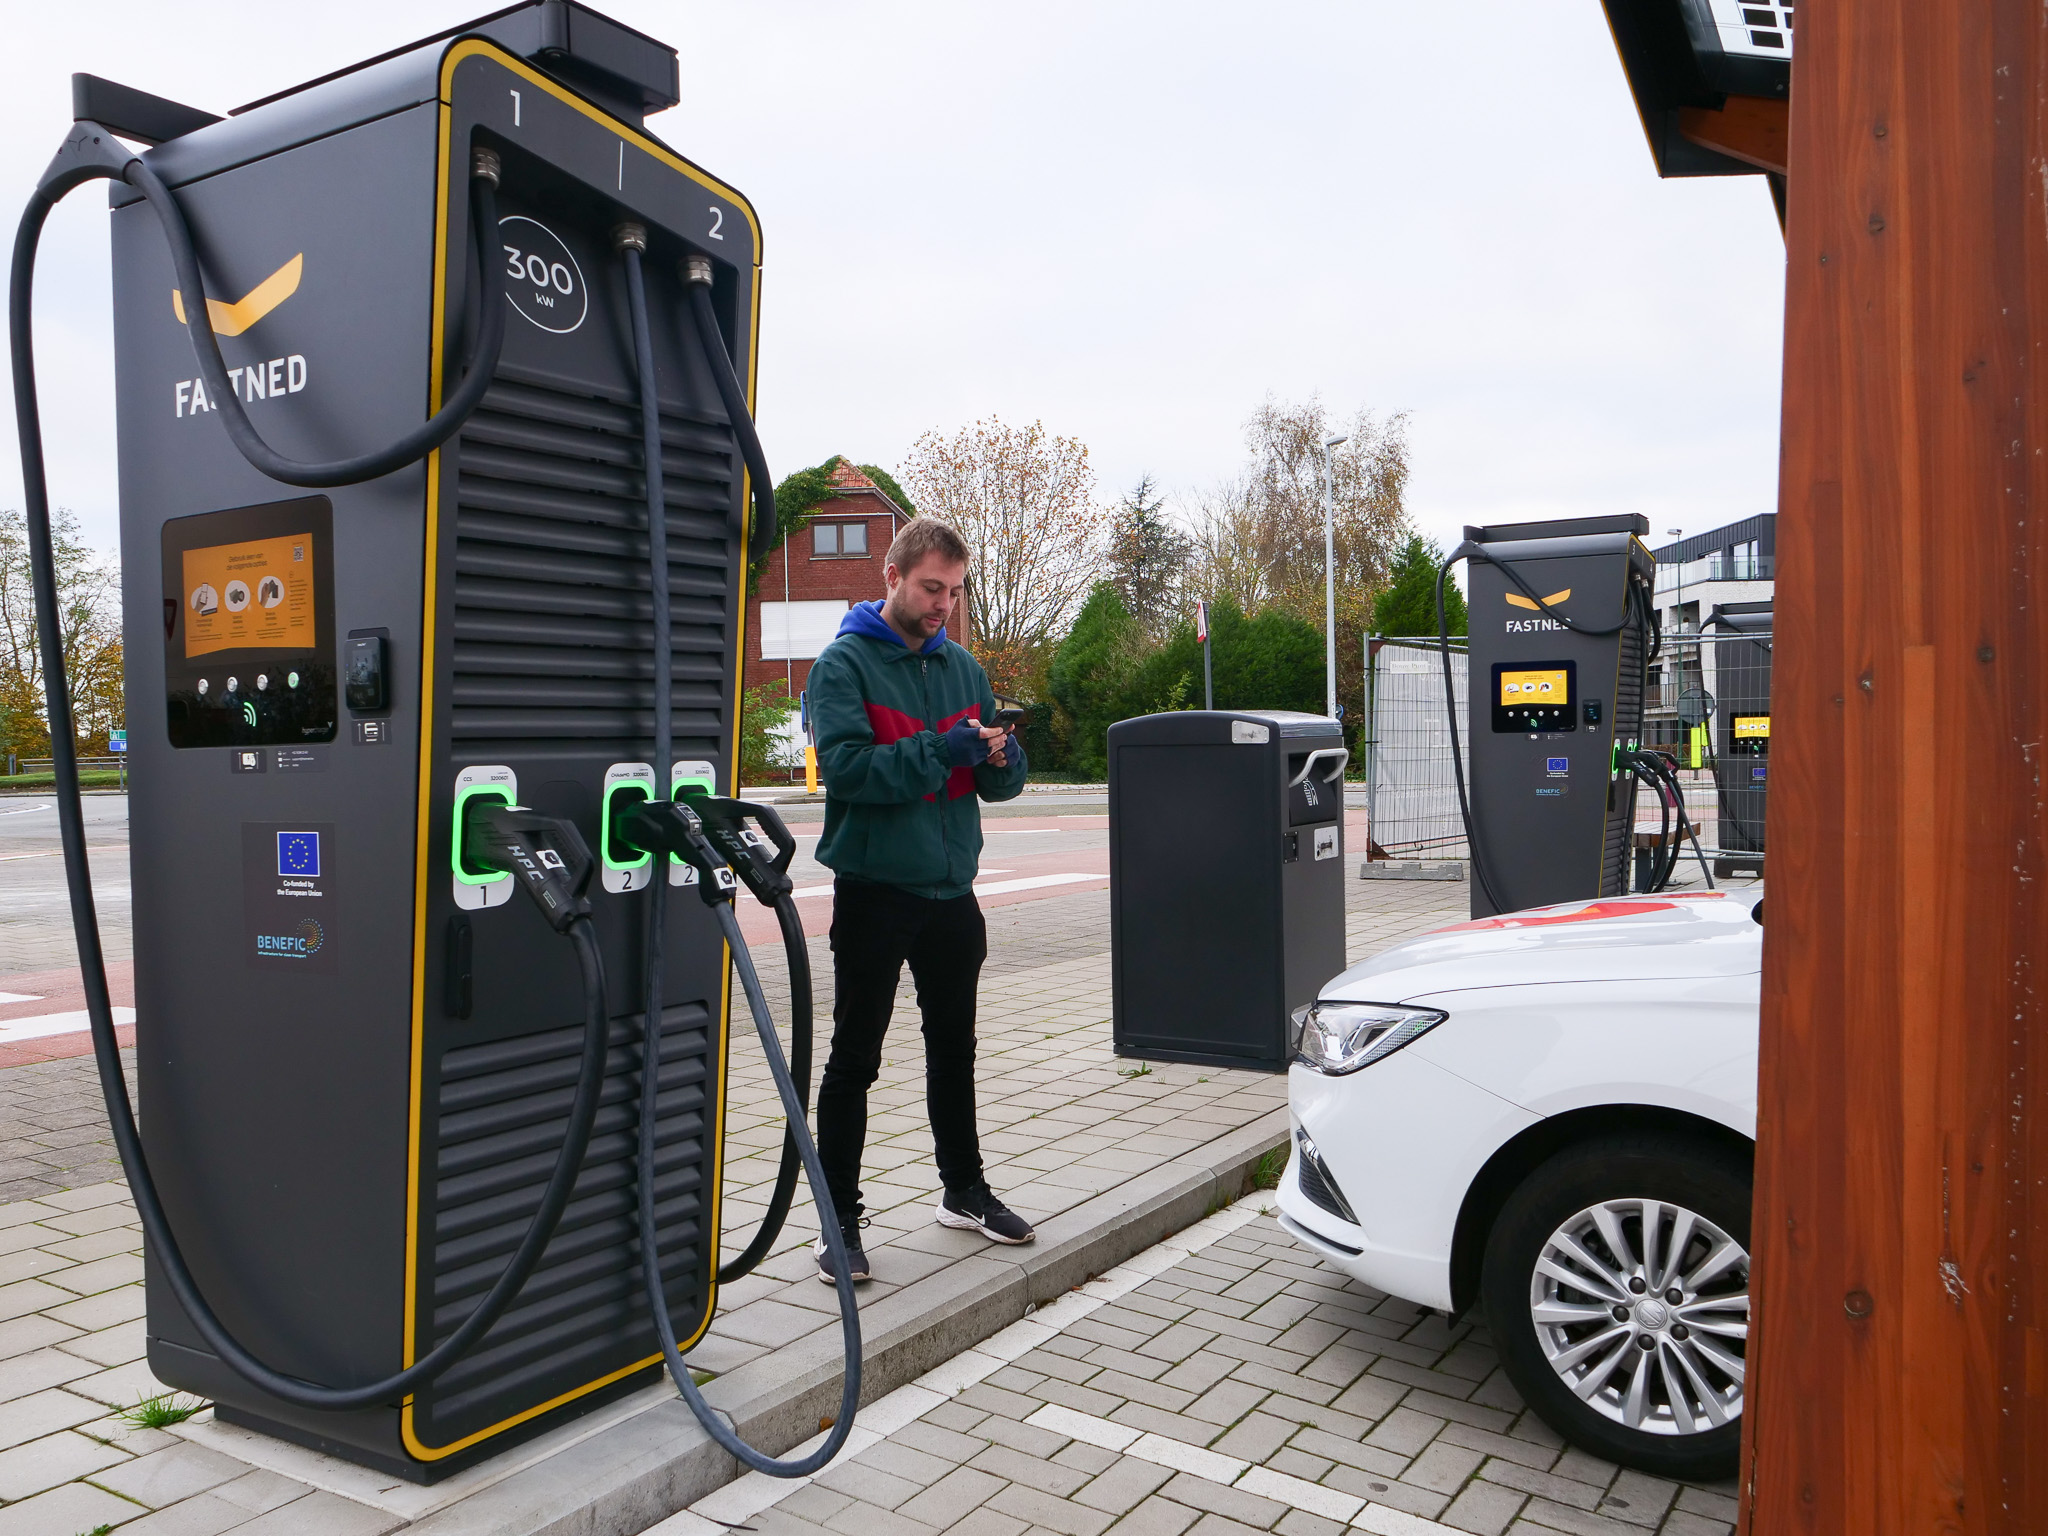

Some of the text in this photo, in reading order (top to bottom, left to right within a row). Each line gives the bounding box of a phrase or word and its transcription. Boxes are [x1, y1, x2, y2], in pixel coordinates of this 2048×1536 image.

[510, 89, 520, 127] 1
[708, 206, 724, 241] 2
[503, 244, 573, 295] 300
[536, 293, 554, 308] kW
[175, 354, 307, 418] FATNED
[1506, 618, 1572, 633] FASTNE
[622, 871, 632, 890] 2
[684, 866, 693, 883] 2
[480, 885, 487, 906] 1
[257, 935, 306, 951] BENEFIC
